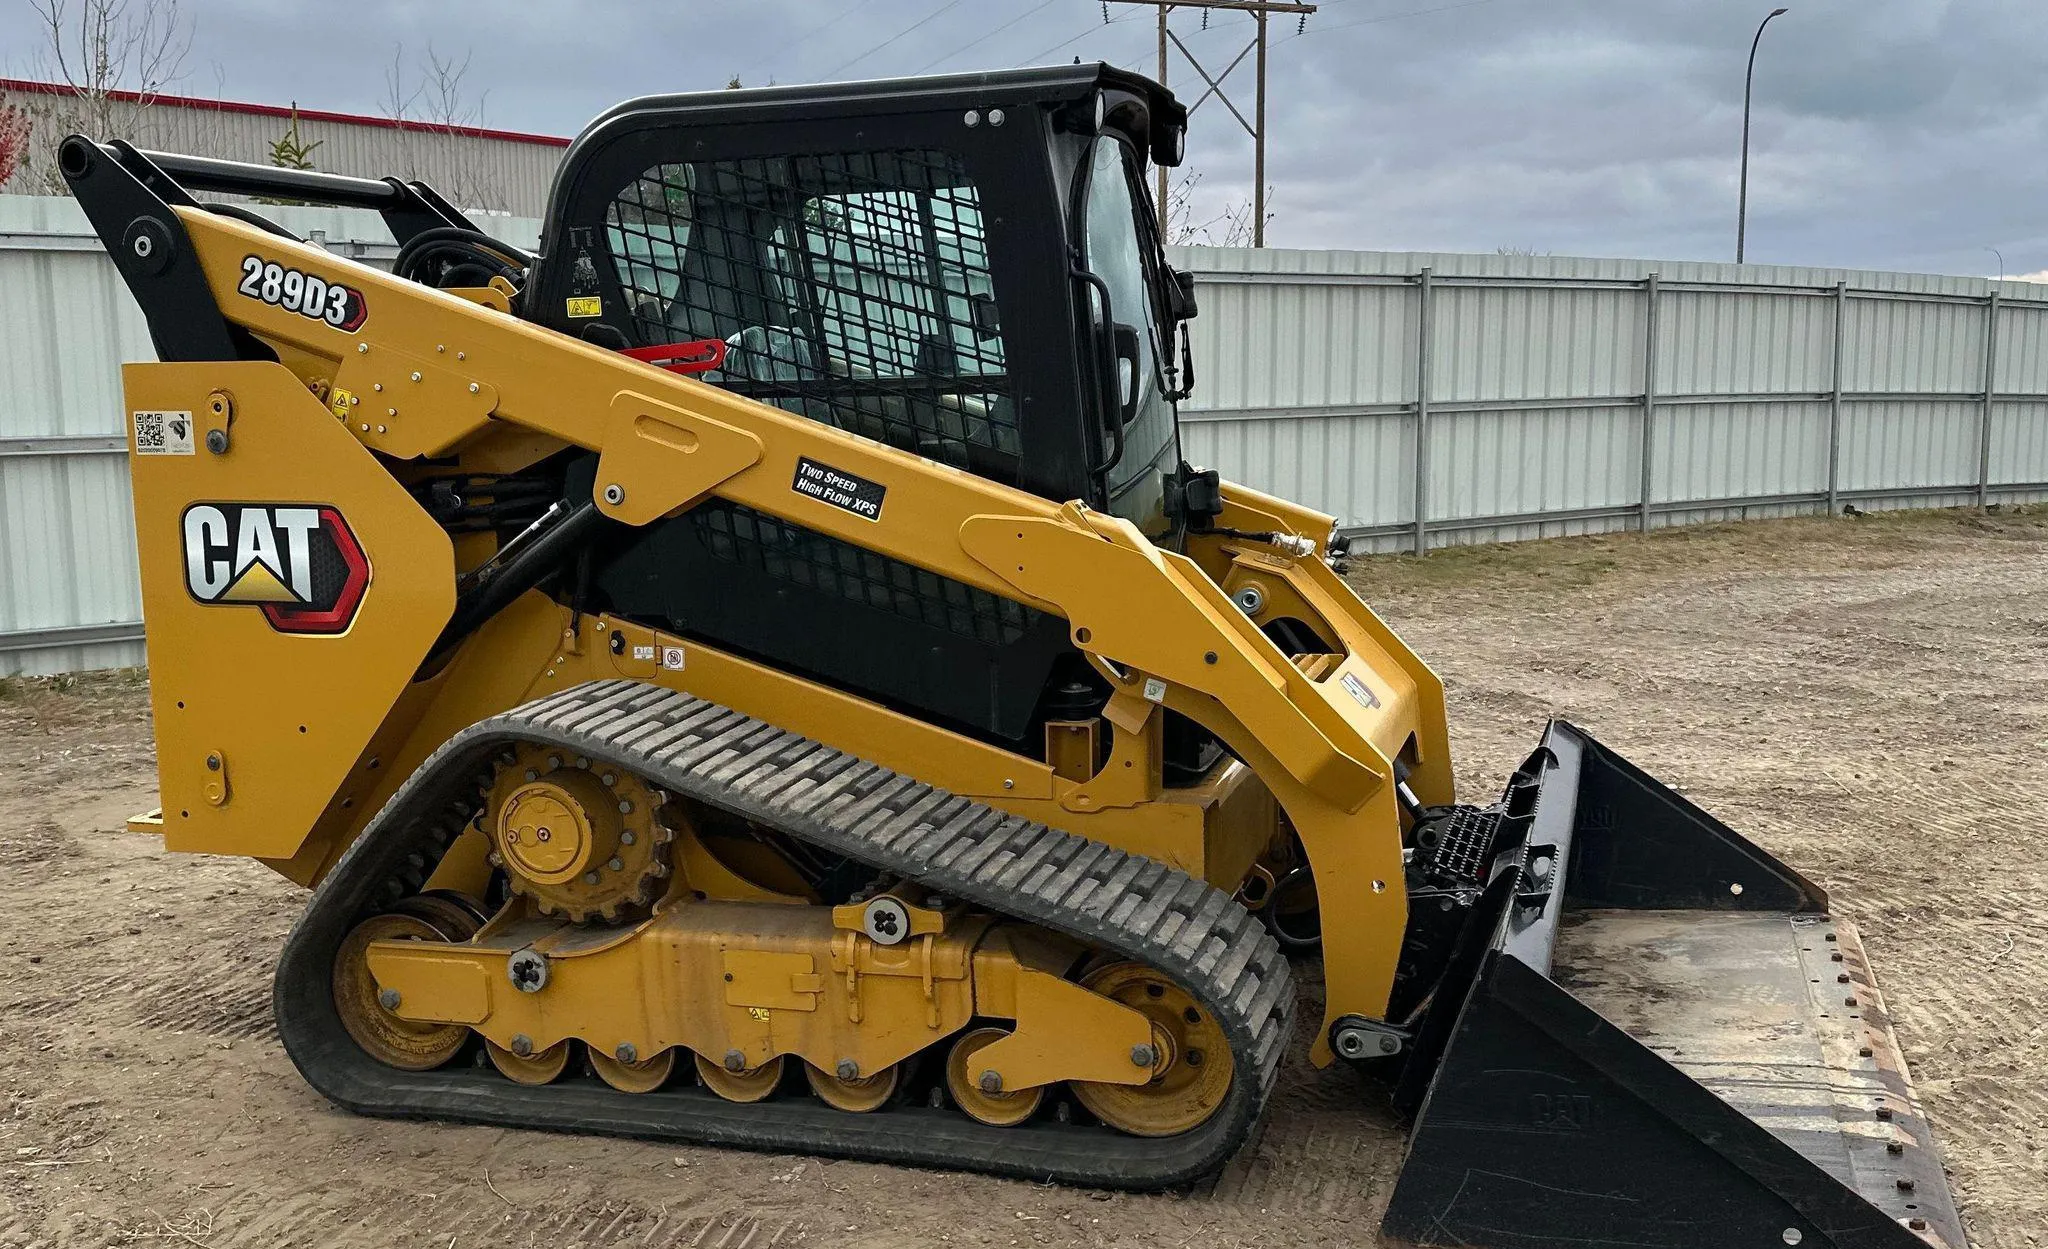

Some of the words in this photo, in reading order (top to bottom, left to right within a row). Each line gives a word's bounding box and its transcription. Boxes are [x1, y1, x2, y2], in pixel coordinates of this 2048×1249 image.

[240, 257, 348, 325] 289D3
[796, 478, 823, 496] HIGH
[823, 487, 852, 506] FLOW
[852, 498, 877, 515] XPS
[800, 462, 824, 480] TWO
[824, 472, 857, 492] SPEED
[184, 505, 319, 602] CAT
